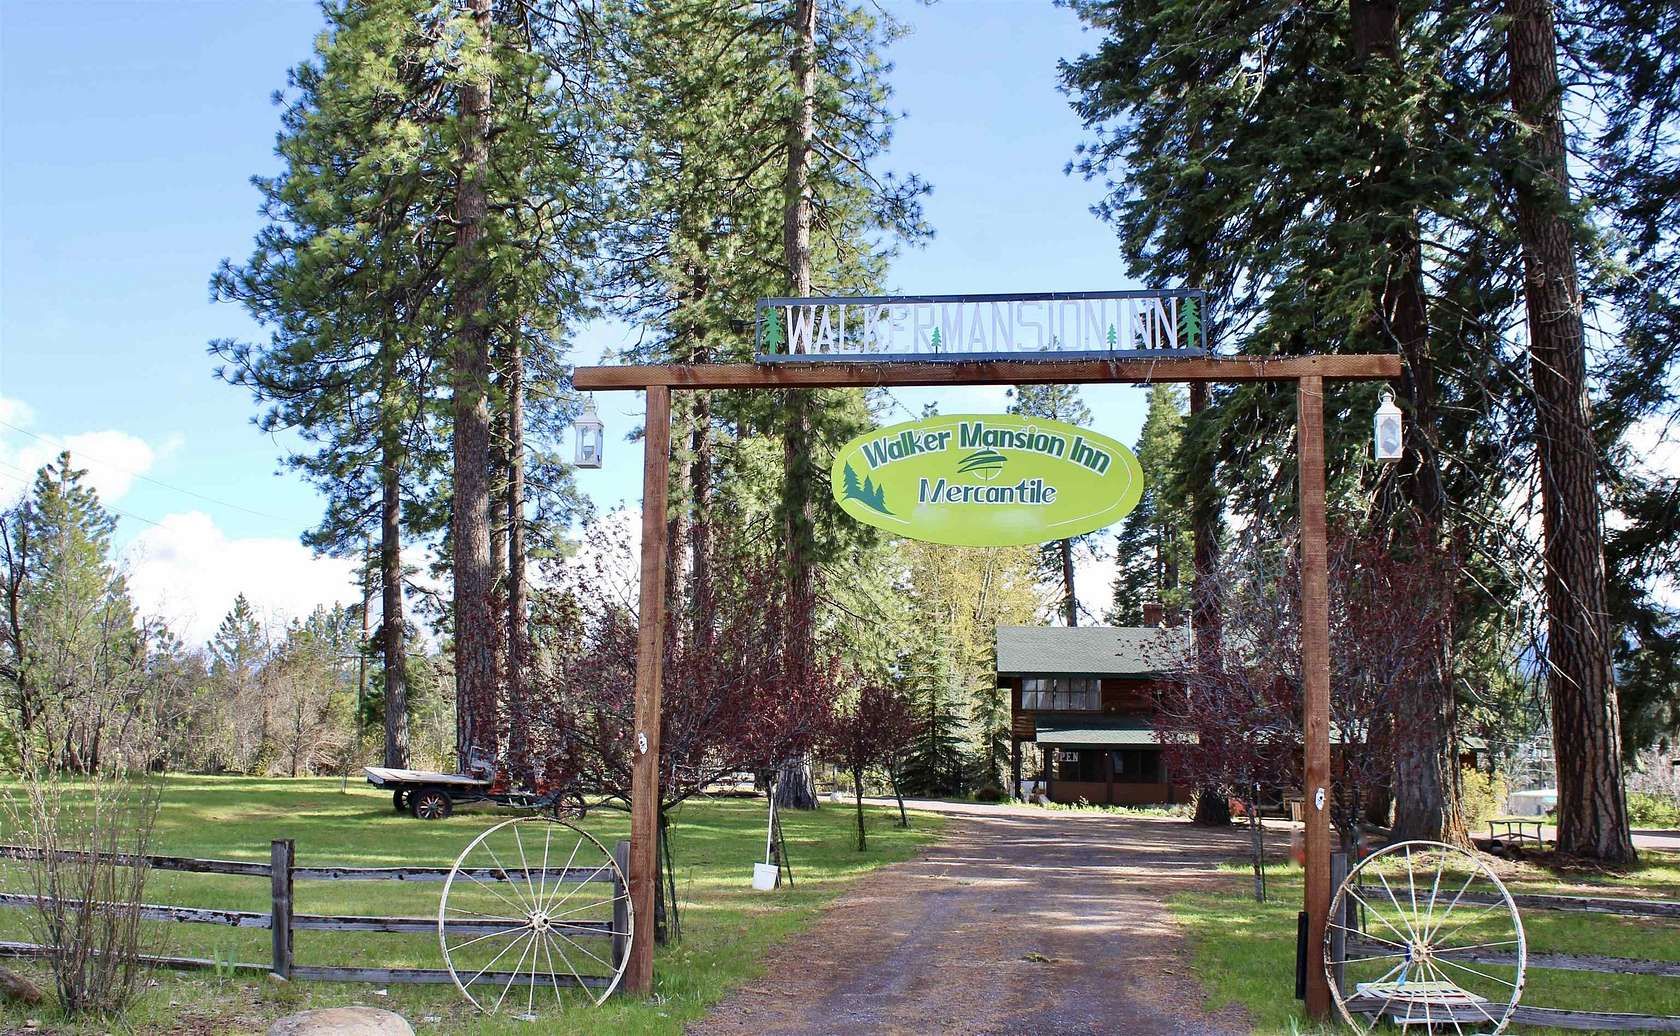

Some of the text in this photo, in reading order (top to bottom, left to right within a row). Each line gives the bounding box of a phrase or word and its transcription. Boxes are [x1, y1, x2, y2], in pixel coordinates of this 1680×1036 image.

[785, 303, 935, 354] WALKER
[941, 301, 1106, 353] MANSION
[862, 421, 1112, 476] Walker Mansion Inn
[918, 477, 1057, 504] Mercantile
